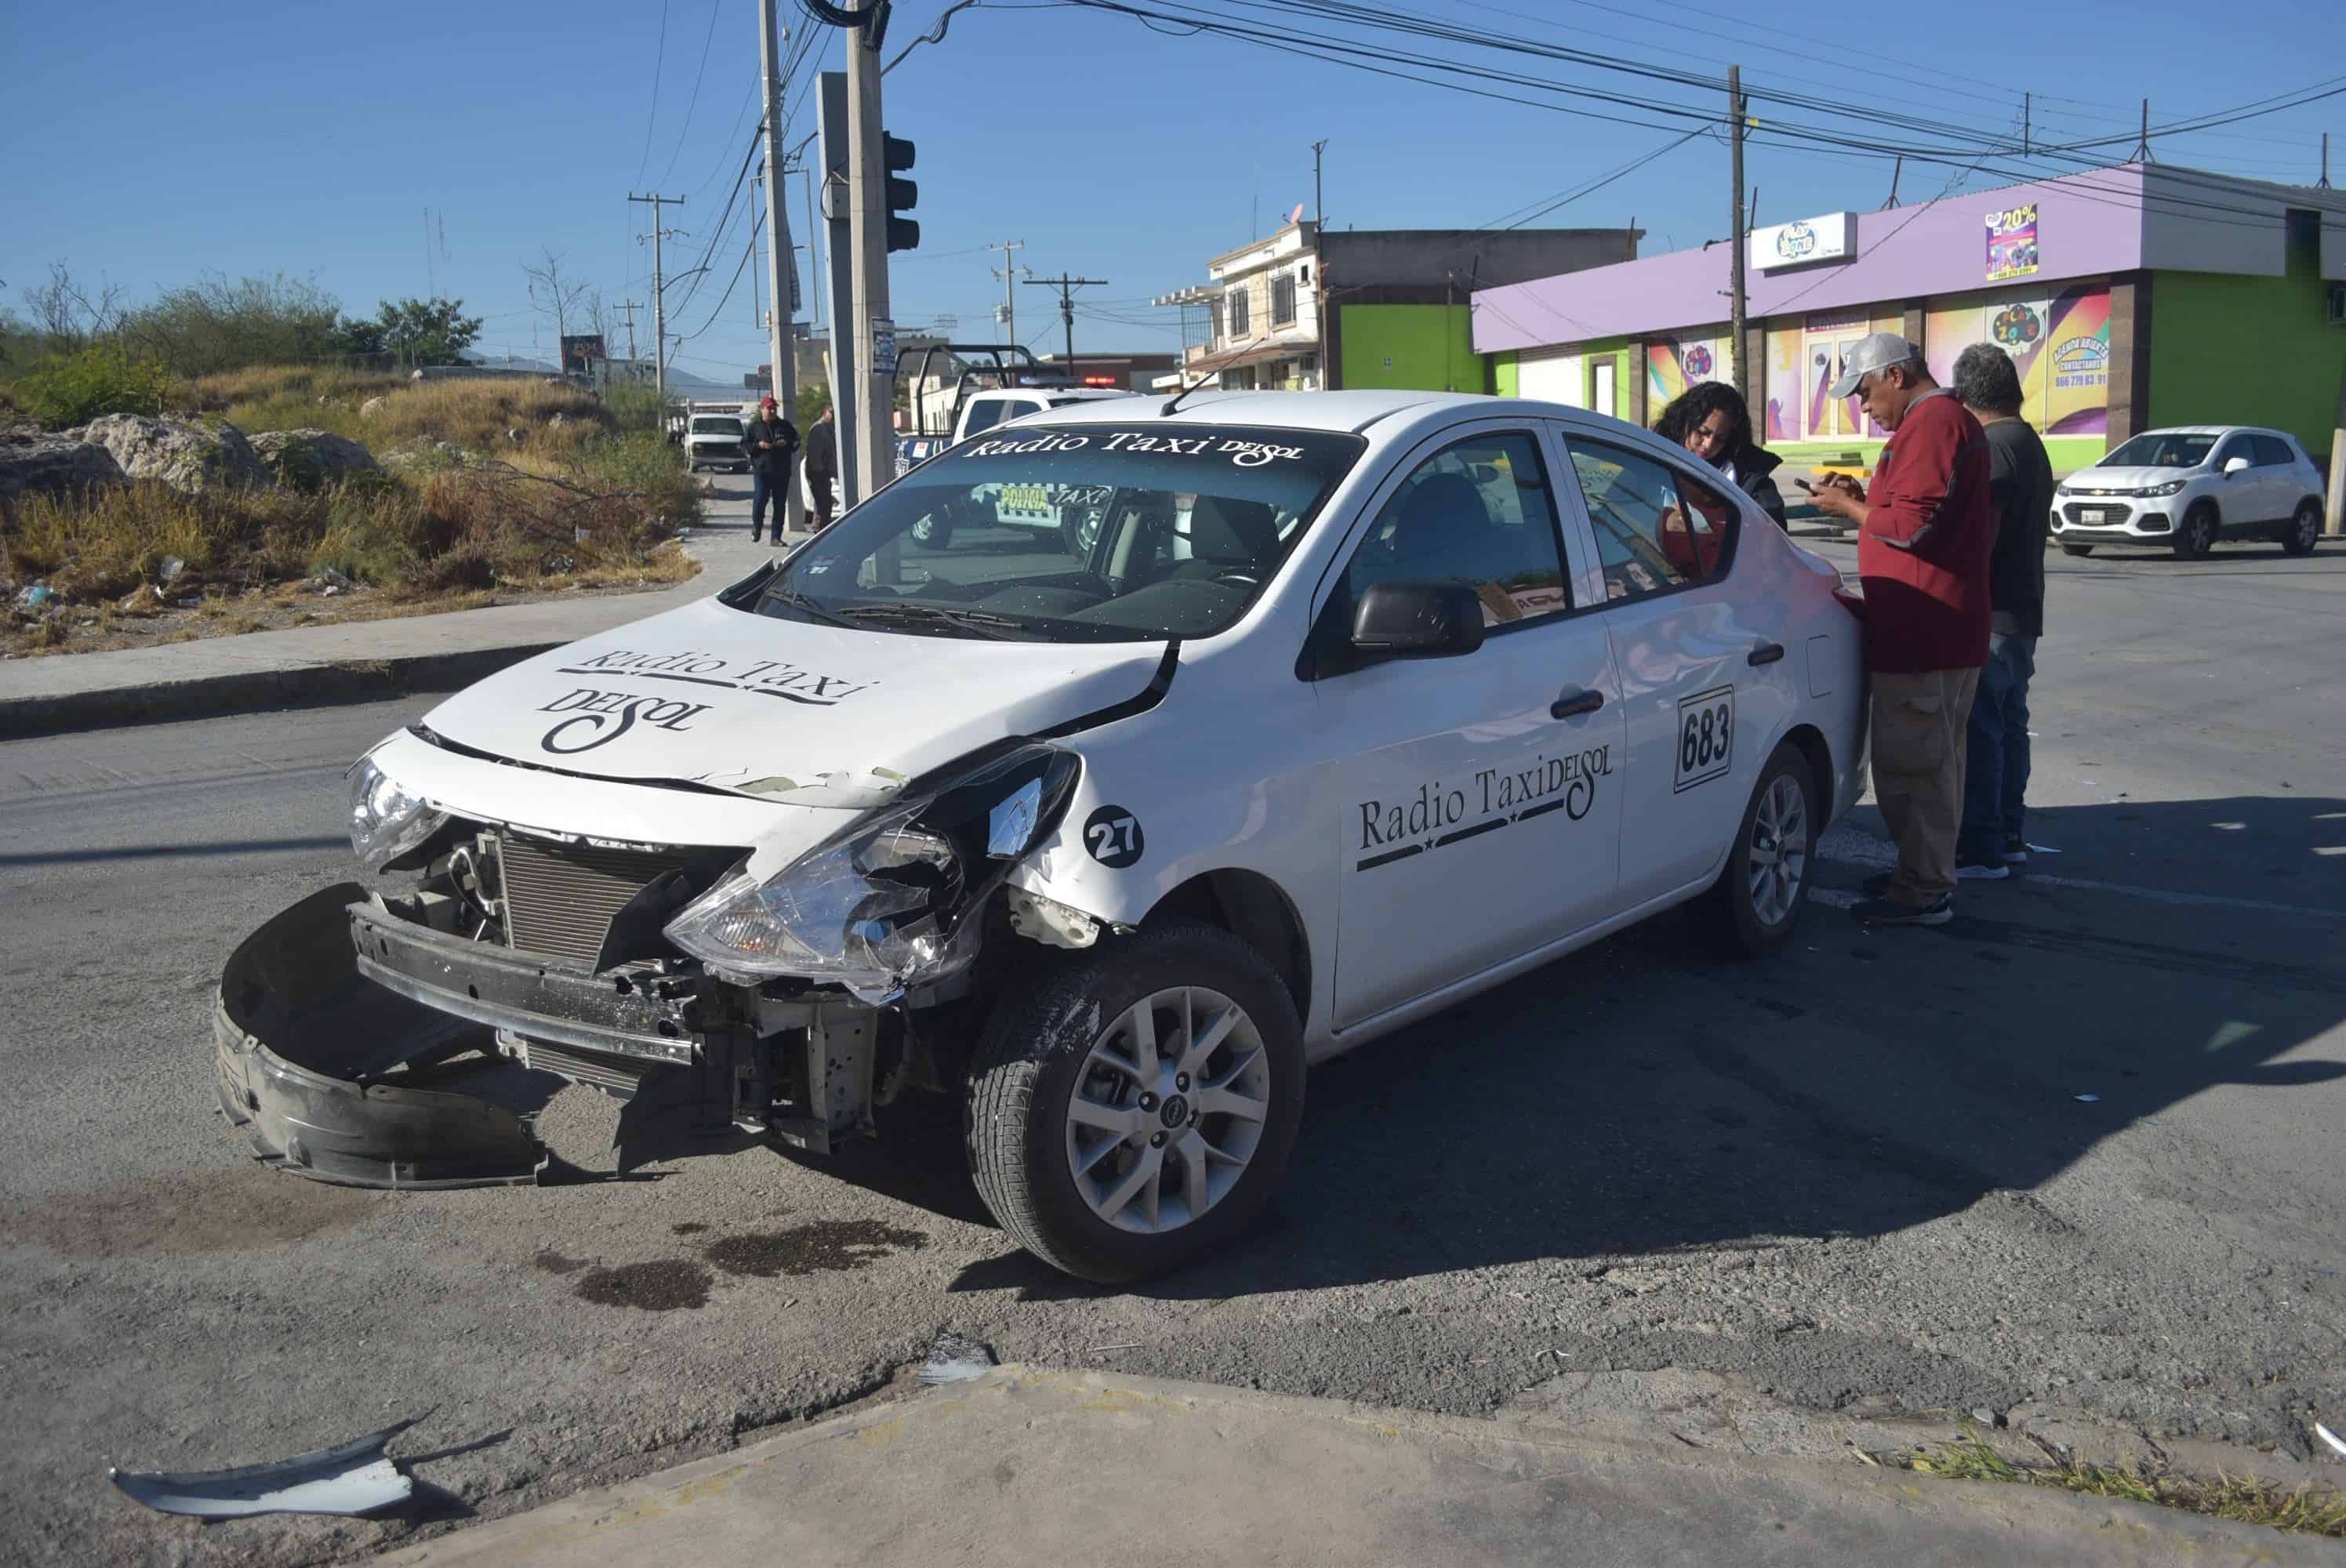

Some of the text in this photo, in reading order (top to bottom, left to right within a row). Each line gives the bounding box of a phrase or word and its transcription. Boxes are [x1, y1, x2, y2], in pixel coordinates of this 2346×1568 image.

[2003, 205, 2036, 230] 20%
[1781, 238, 1813, 253] ZONE
[2054, 336, 2108, 364] AGENDA ABIERTA
[2056, 376, 2070, 387] 866
[2070, 375, 2083, 387] 279
[963, 434, 1091, 458] Radio
[1100, 432, 1217, 456] Taxi
[1000, 487, 1049, 511] POLICIA
[577, 650, 881, 698] Radio Taxi
[1682, 702, 1730, 772] 683
[1359, 781, 1465, 850] Radio
[1476, 754, 1544, 815] Taxi
[1088, 816, 1135, 859] 27
